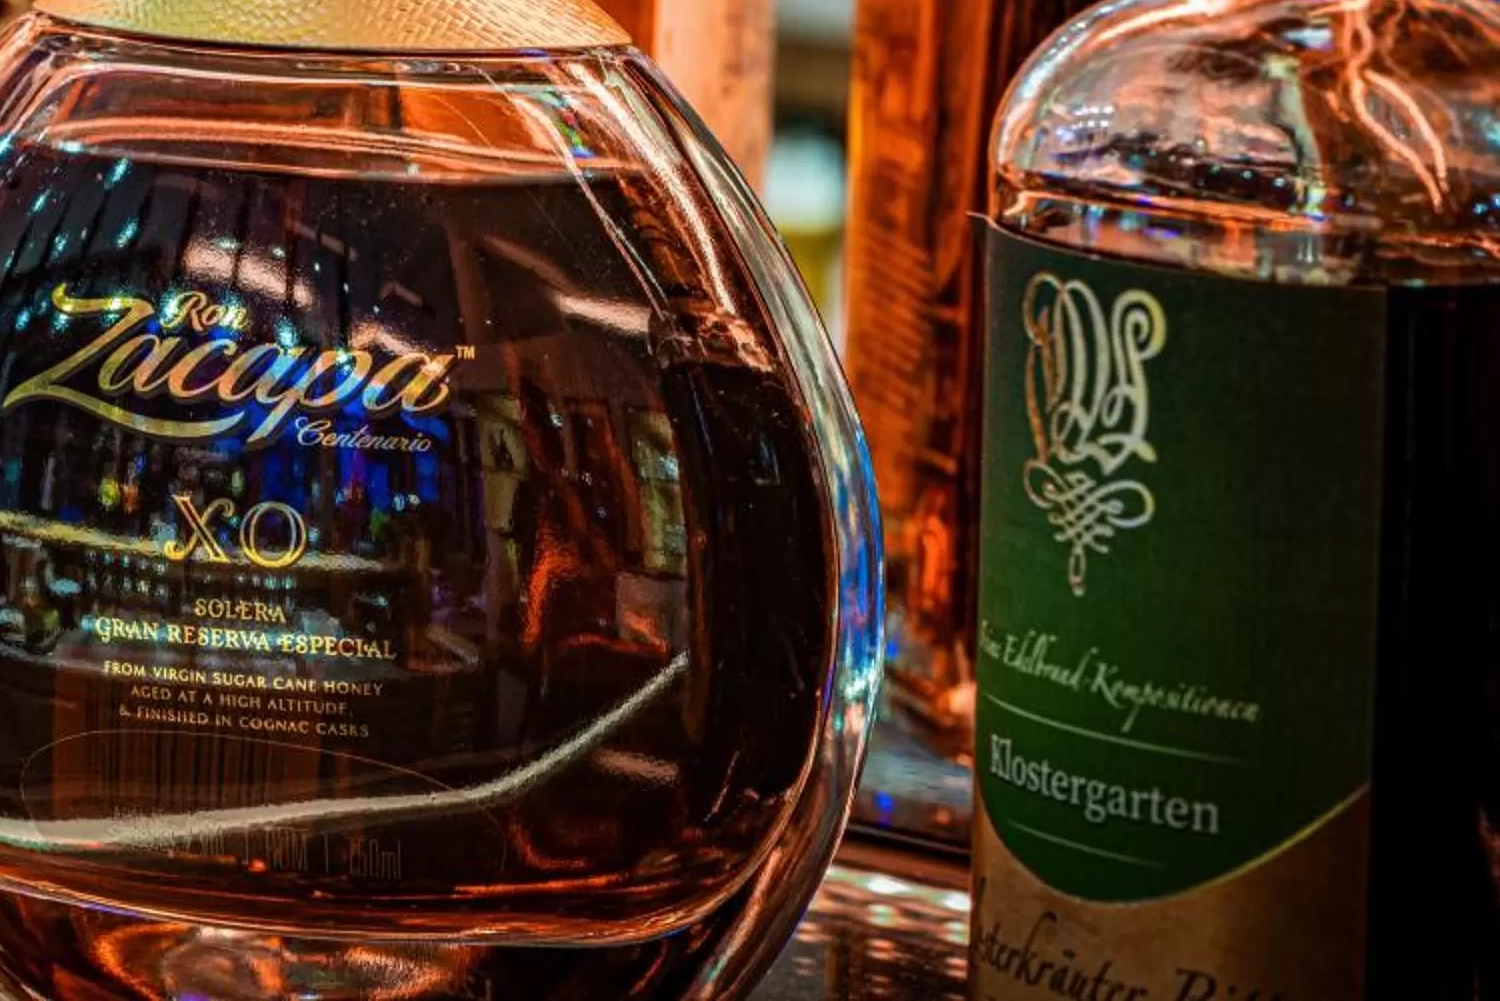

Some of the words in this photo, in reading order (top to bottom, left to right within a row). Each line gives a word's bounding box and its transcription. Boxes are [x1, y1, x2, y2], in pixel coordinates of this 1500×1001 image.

[161, 290, 250, 332] Ron
[3, 283, 456, 444] Zacapa
[294, 414, 432, 453] Centenario
[163, 494, 307, 569] XO
[194, 598, 287, 624] SOLERA
[95, 616, 158, 644] GRAN
[167, 624, 272, 653] RESERVA
[276, 633, 398, 661] ESPECIAL
[103, 660, 147, 677] FROM
[152, 666, 206, 684] VIRGIN
[212, 672, 267, 689] SUGAR
[273, 677, 318, 693] CANE
[323, 680, 384, 697] HONEY
[131, 686, 172, 701] AGED
[178, 689, 197, 703] AT
[202, 691, 214, 705] A
[219, 693, 261, 710] HIGH
[119, 704, 131, 717] &
[136, 705, 209, 726] FINISHED
[215, 712, 232, 728] IN
[239, 716, 309, 735] COGNAC
[315, 721, 370, 739] CASKS
[989, 732, 1221, 836] Klostergarten
